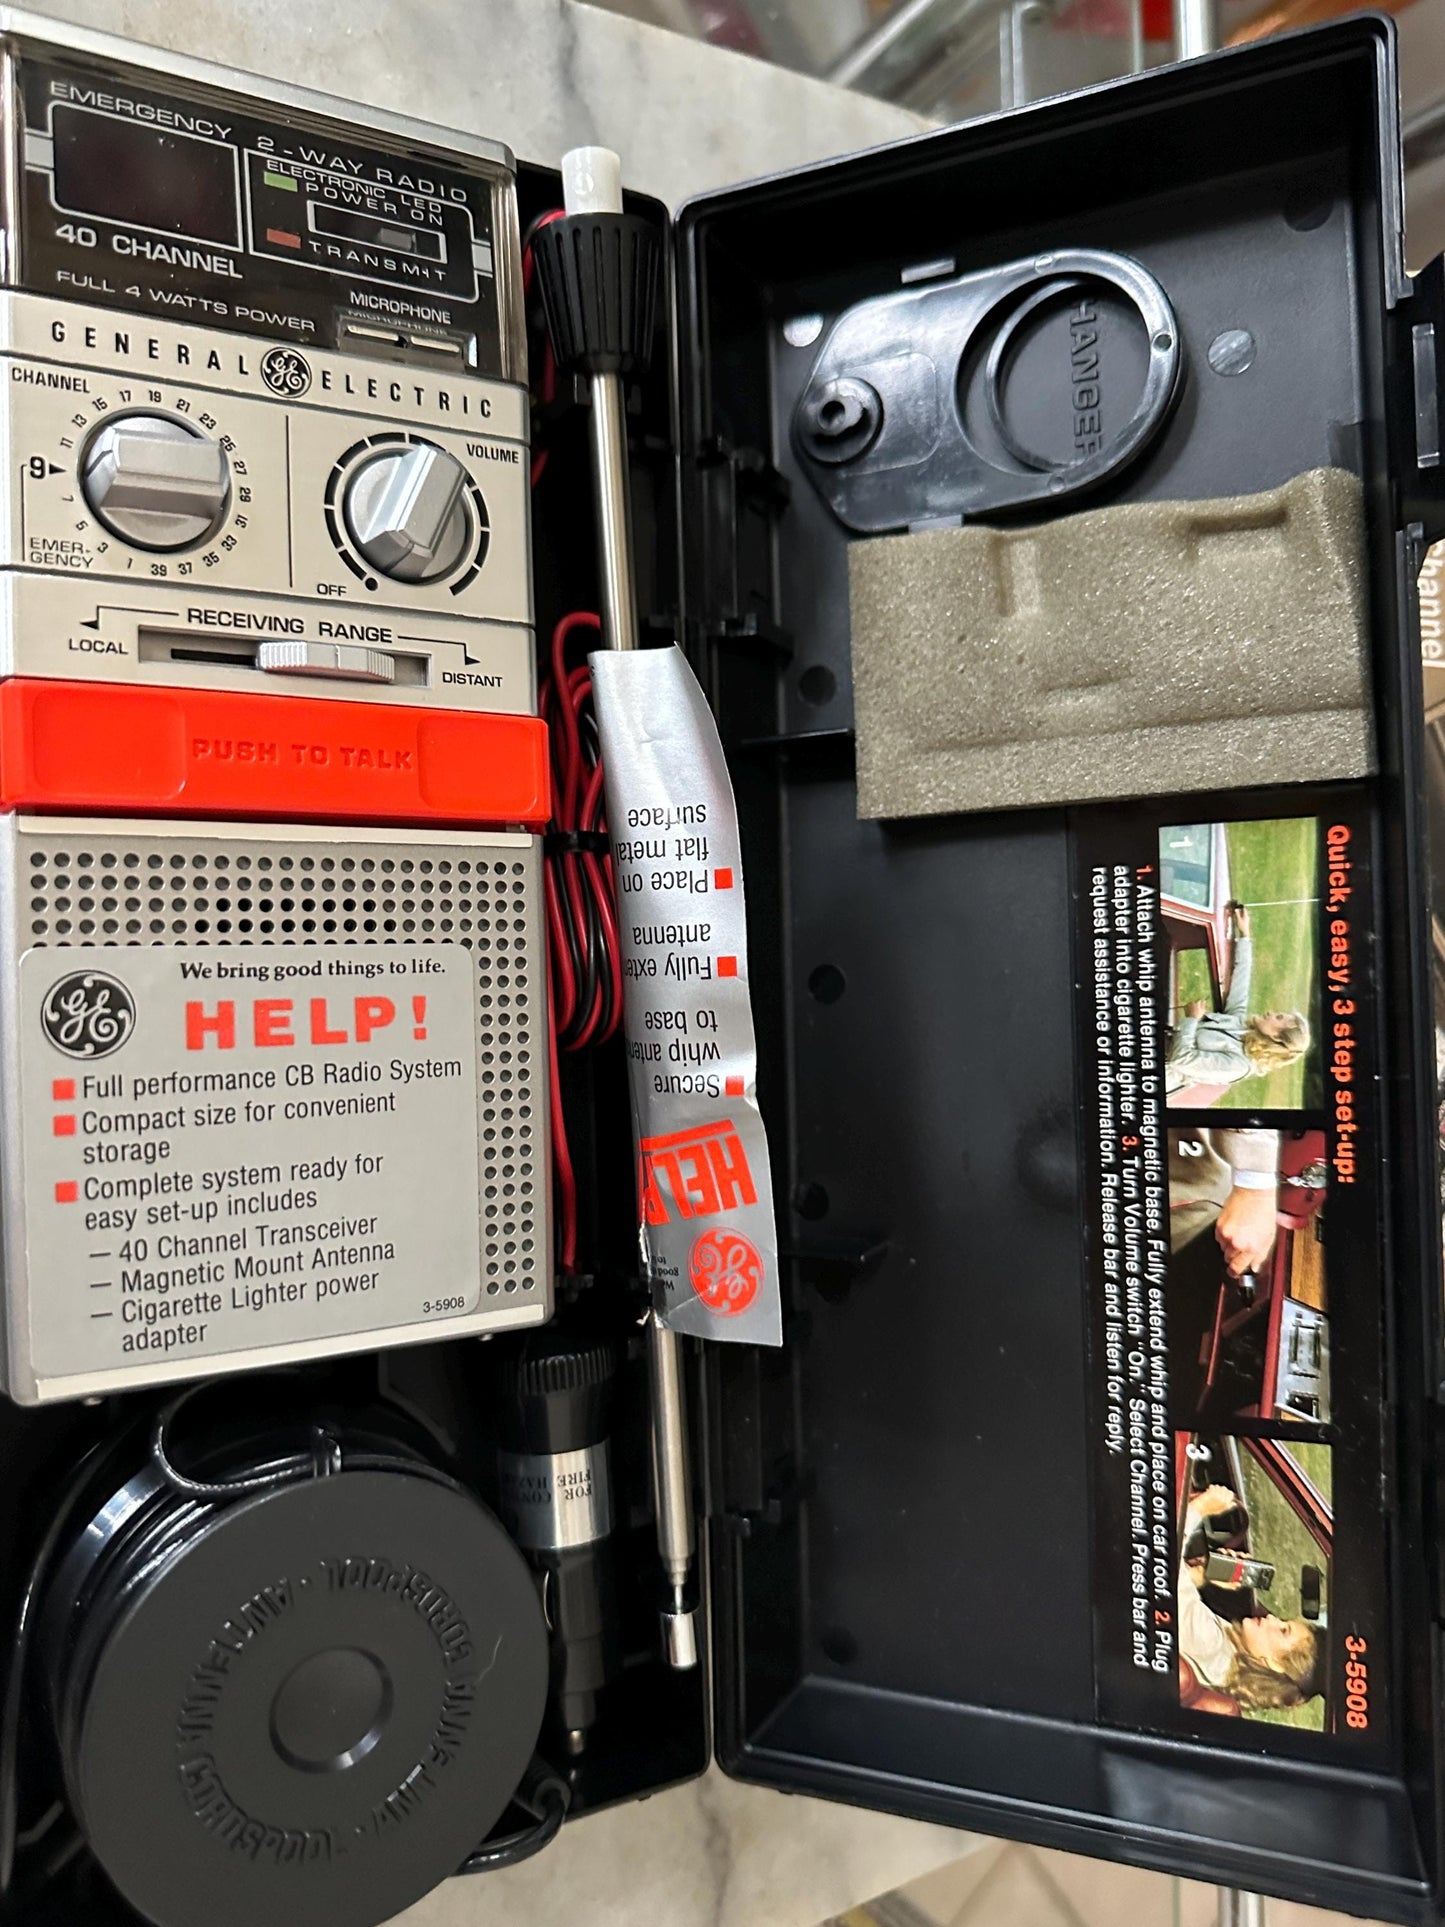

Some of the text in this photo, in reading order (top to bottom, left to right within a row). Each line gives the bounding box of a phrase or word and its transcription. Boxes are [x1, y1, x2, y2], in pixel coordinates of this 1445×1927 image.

[50, 81, 232, 140] EMERGENCY
[376, 168, 467, 202] RADIO
[266, 159, 441, 213] ELECTRONIC LED
[306, 182, 442, 226] POWER ON
[55, 224, 243, 279] 40 CHANNEL
[57, 270, 315, 332] FULL 4 WATTS POWER
[350, 291, 451, 324] MICROPHONE
[52, 321, 249, 375] GENERAL
[12, 367, 90, 393] CHANNEL
[322, 370, 491, 418] ELECTRIC
[92, 399, 108, 412] 15
[121, 390, 132, 401] 17
[149, 390, 161, 402] 19
[176, 399, 191, 413] 21
[73, 414, 87, 428] 13
[200, 414, 216, 429] 23
[61, 438, 73, 449] 11
[466, 443, 518, 464] VOLUME
[30, 457, 46, 478] 9
[235, 460, 246, 475] 27
[236, 514, 247, 529] 31
[30, 537, 91, 554] EMER-
[98, 542, 108, 553] 3
[222, 536, 237, 551] 33
[30, 551, 93, 568] GENCY
[179, 563, 192, 574] 37
[204, 553, 219, 567] 35
[317, 583, 347, 596] OFF
[188, 608, 392, 644] RECEIVING RANGE
[69, 638, 128, 655] LOCAL
[442, 672, 503, 687] DISTANT
[192, 738, 413, 770] PUSH TO TALK
[628, 804, 706, 831] surface
[615, 837, 709, 865] flat metal
[622, 869, 708, 894] Place on
[1111, 866, 1131, 934] adapter
[632, 923, 711, 947] antenna
[180, 958, 445, 981] We bring good things to life.
[664, 952, 711, 981] Fully
[1116, 939, 1132, 974] into
[1113, 979, 1134, 1057] cigarette
[1327, 825, 1356, 1183] Quick, easy, 3 step set-up:
[186, 996, 426, 1051] HELP!
[644, 1010, 718, 1034] to base
[668, 1038, 720, 1067] whip
[83, 1059, 461, 1101] Full performance CB Radio System
[654, 1074, 720, 1098] Secure
[1116, 1062, 1137, 1124] lighter.
[82, 1092, 395, 1136] Compact size for convenient
[83, 1141, 170, 1165] storage
[1122, 1136, 1138, 1151] 3.
[1178, 1141, 1202, 1157] 2
[1089, 867, 1125, 1454] request assistance or information. Release bar and listen for reply.
[84, 1153, 383, 1201] Complete system ready for
[1122, 1156, 1139, 1198] Turn
[85, 1188, 317, 1232] easy set-up includes
[119, 1216, 377, 1262] 40 Channel Transceiver
[1124, 1203, 1141, 1272] Volume
[122, 1243, 395, 1294] Magnetic Mount Antenna
[1135, 865, 1172, 1672] 1. Attach whip antenna to magnetic base. Fully extend whip and place on car roof. 2. Plug
[122, 1273, 379, 1325] Cigarette Lighter power
[423, 1296, 465, 1313] 3-5908
[1126, 1277, 1144, 1335] switch
[122, 1324, 207, 1353] adapter
[1129, 1398, 1147, 1455] Select
[1186, 1443, 1212, 1460] 3
[557, 1469, 591, 1487] FIRE
[565, 1484, 592, 1500] FOR
[1130, 1460, 1147, 1538] Channel.
[1132, 1543, 1149, 1593] Press
[1133, 1597, 1148, 1629] bar
[1133, 1631, 1149, 1667] and
[1347, 1637, 1367, 1728] 3-5908
